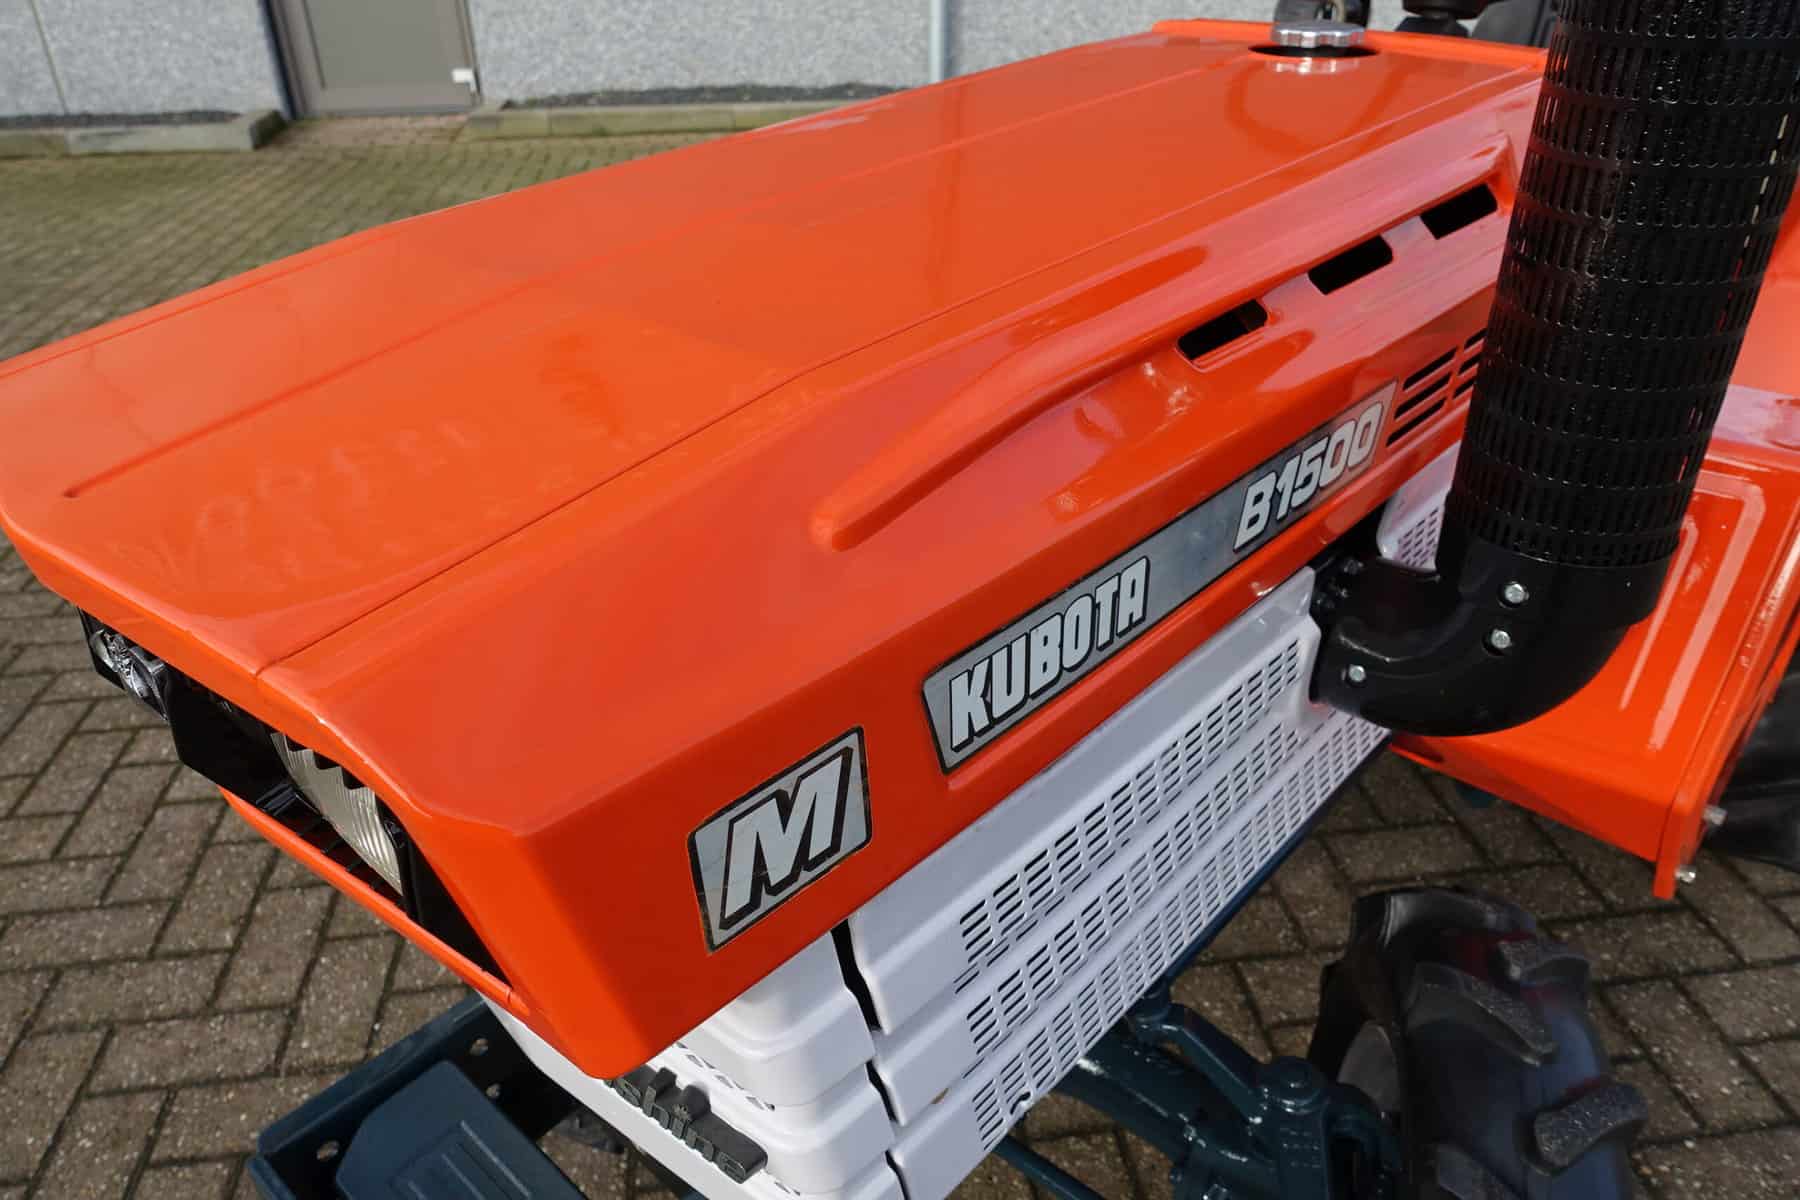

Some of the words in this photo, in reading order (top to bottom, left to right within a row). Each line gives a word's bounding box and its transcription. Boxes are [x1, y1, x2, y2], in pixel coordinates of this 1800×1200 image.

[949, 557, 1151, 752] KUBOTA
[1233, 402, 1384, 551] B1500
[720, 746, 853, 930] M
[605, 1078, 747, 1184] shine
